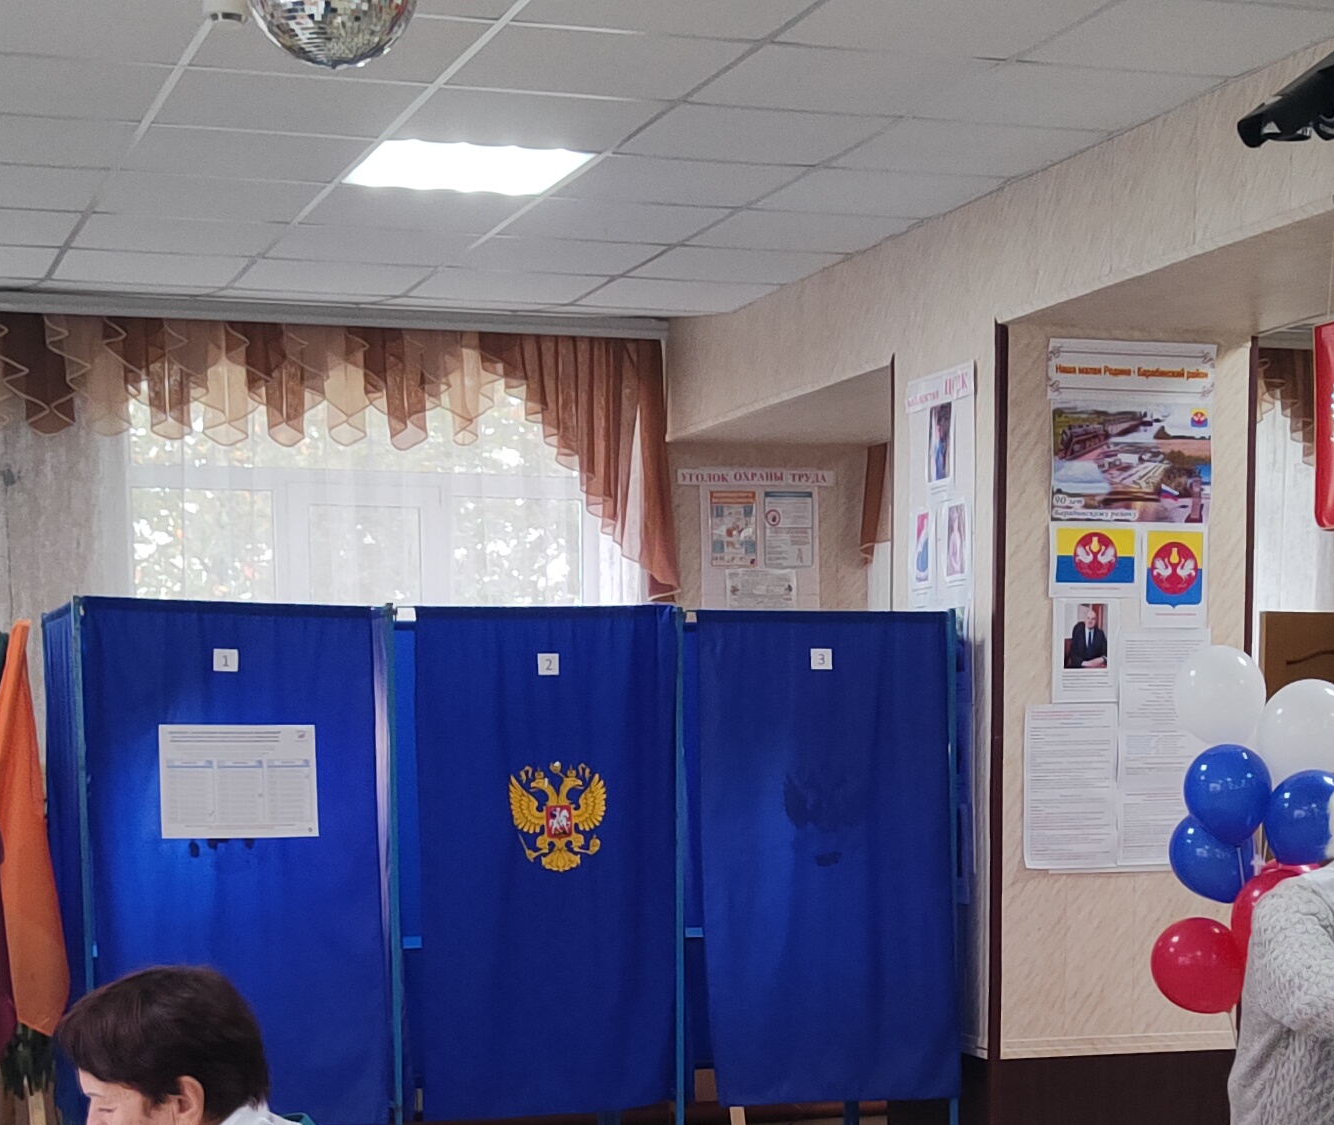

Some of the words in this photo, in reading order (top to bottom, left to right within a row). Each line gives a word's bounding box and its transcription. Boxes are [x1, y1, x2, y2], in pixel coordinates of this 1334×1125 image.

[681, 472, 729, 483] УГОЛОК
[733, 471, 784, 482] ОХРАНЫ
[790, 472, 827, 483] ТРУДА
[222, 654, 230, 667] 1
[545, 658, 553, 671] 2
[817, 653, 826, 666] 3
